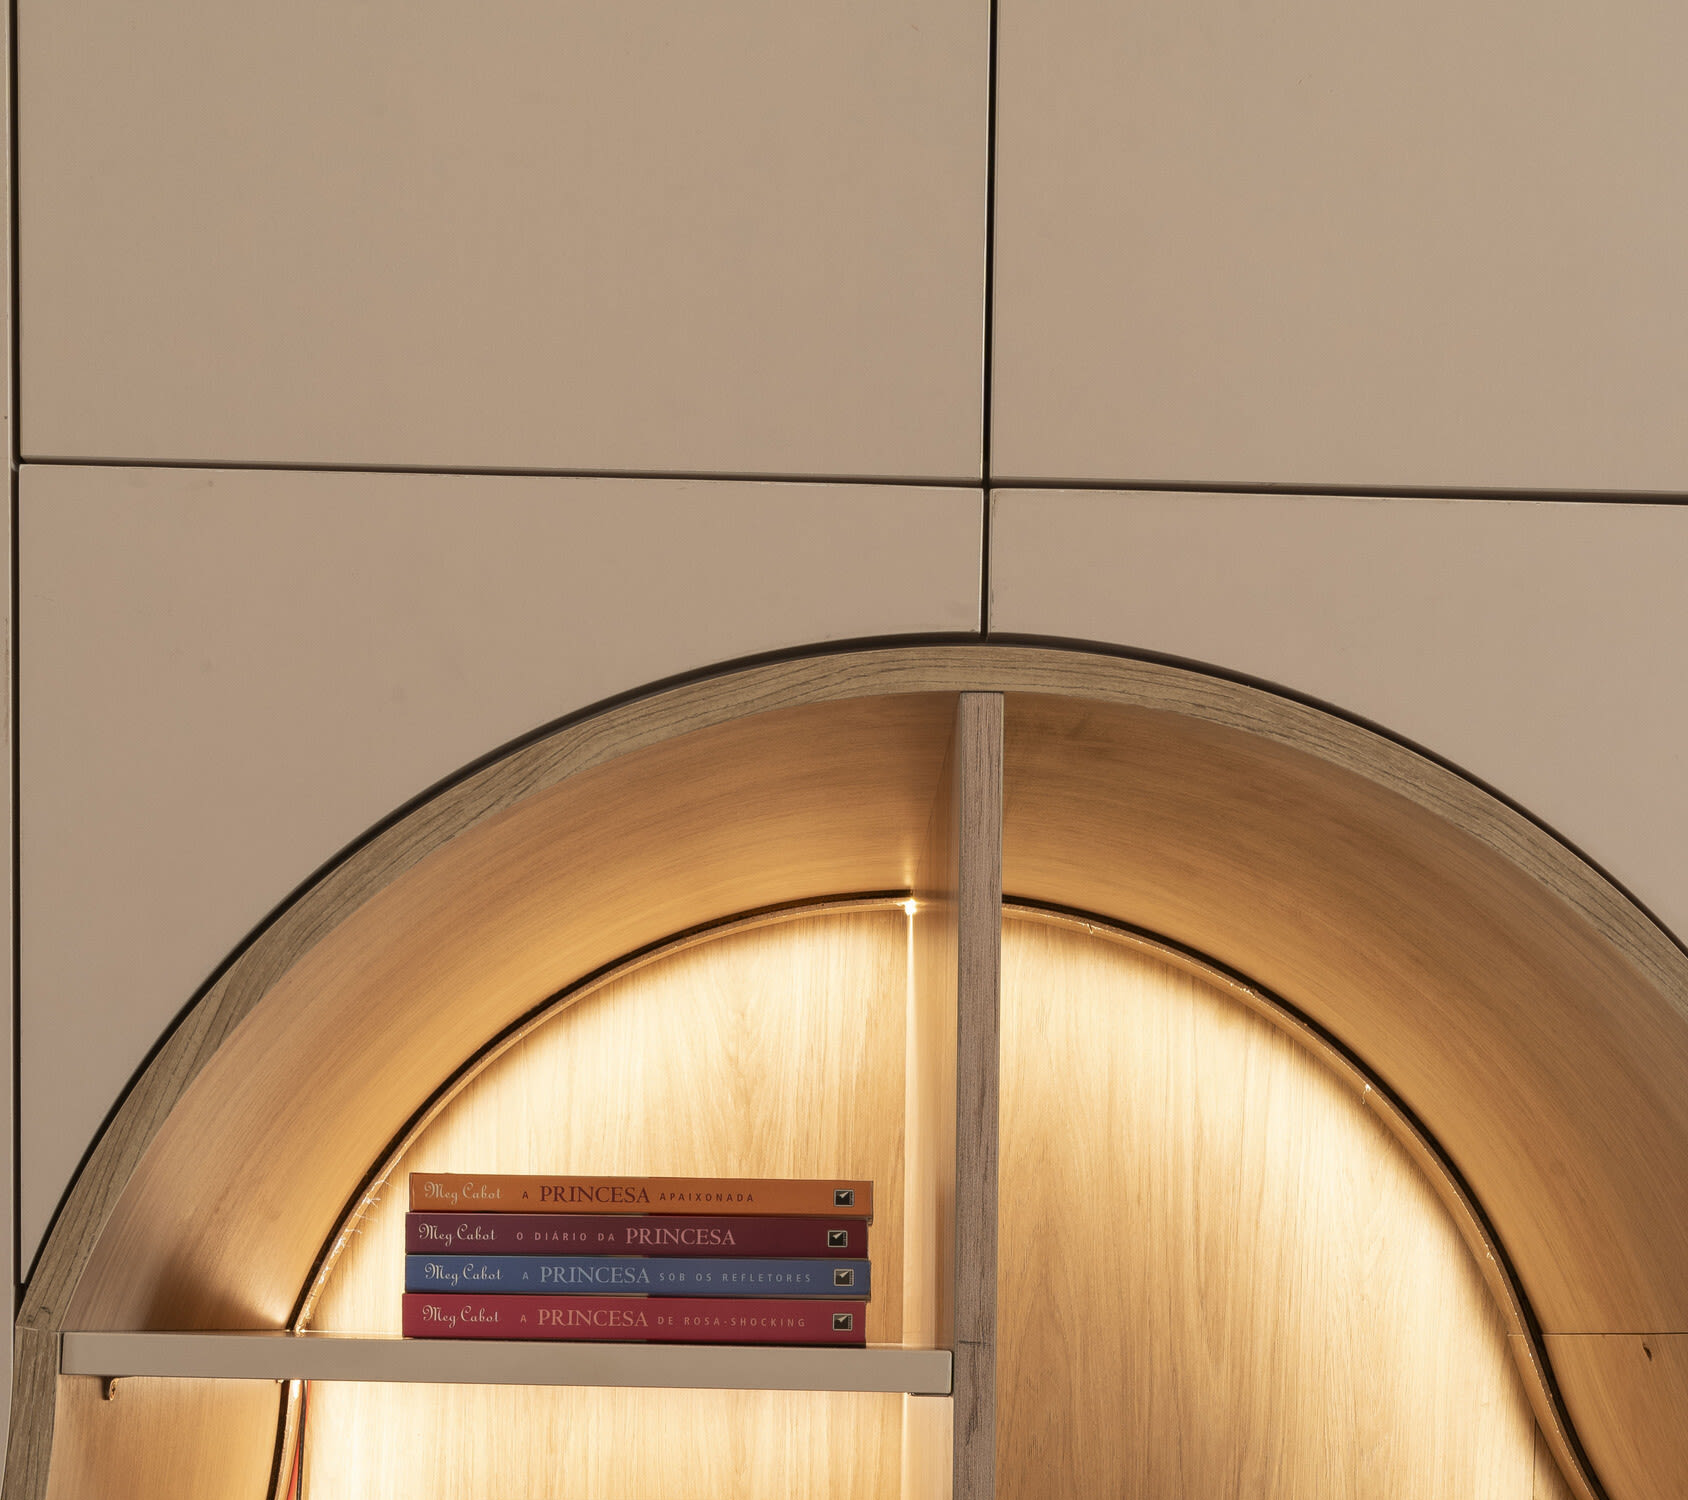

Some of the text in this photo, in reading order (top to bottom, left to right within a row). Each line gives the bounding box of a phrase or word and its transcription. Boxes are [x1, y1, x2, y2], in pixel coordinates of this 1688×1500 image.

[424, 1182, 502, 1204] Meg Cabot
[522, 1185, 754, 1204] A PRINCESA APAIXONADA
[418, 1223, 497, 1247] Meg Cabot
[516, 1227, 736, 1246] O DIÁRIO DA PRINCESA
[424, 1262, 503, 1287] Meg Cabot
[522, 1266, 811, 1284] A PRINCESA SOB OS REFLETORES
[422, 1304, 499, 1328] Meg Cabot
[520, 1308, 806, 1328] A PRINCESA DE ROSA-SHOCKING
